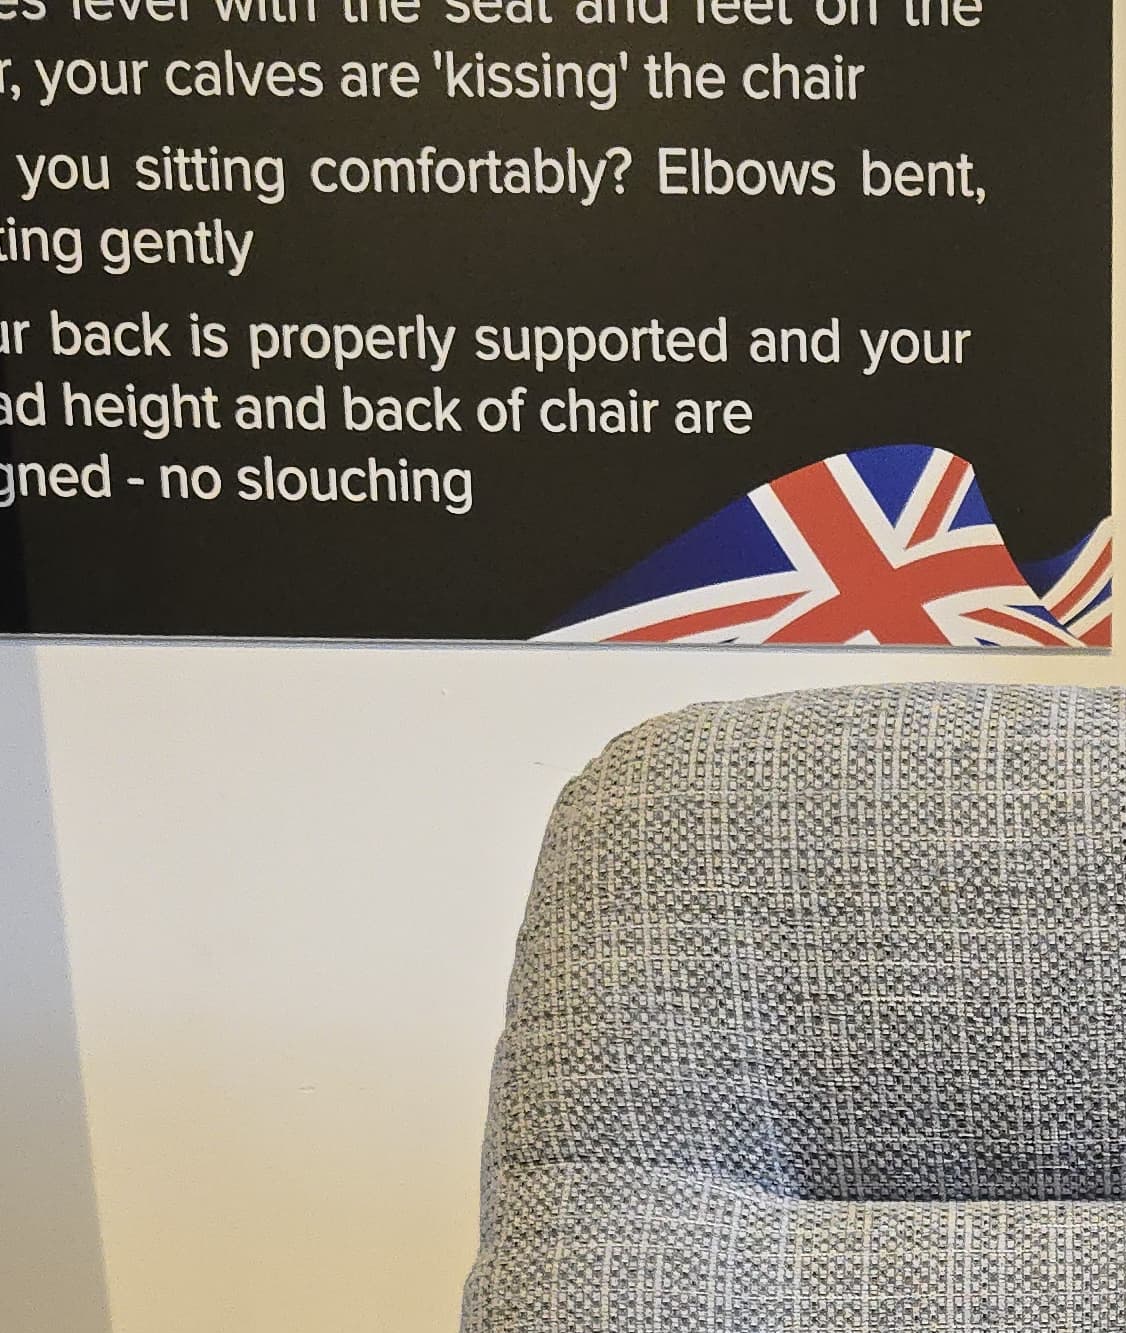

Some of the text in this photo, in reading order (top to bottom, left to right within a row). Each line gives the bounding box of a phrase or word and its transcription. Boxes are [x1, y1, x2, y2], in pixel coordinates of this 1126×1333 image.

[35, 60, 148, 106] your
[166, 49, 324, 98] calves
[341, 61, 420, 98] are
[433, 50, 628, 110] 'kissing'
[644, 52, 726, 100] the
[742, 53, 865, 101] chair
[16, 146, 986, 206] you sitting comfortably? Elbows bent,
[100, 218, 254, 277] gently
[50, 310, 172, 357] back
[190, 312, 229, 358] is
[249, 314, 457, 371] properly
[475, 317, 728, 373] supported
[749, 318, 840, 364] and
[859, 329, 972, 376] your
[62, 382, 222, 440] height
[234, 384, 326, 431] and
[342, 386, 462, 432] back
[477, 387, 532, 432] of
[540, 388, 660, 434] chair
[674, 399, 753, 435] are
[160, 464, 222, 500] no
[238, 456, 473, 515] slouching
